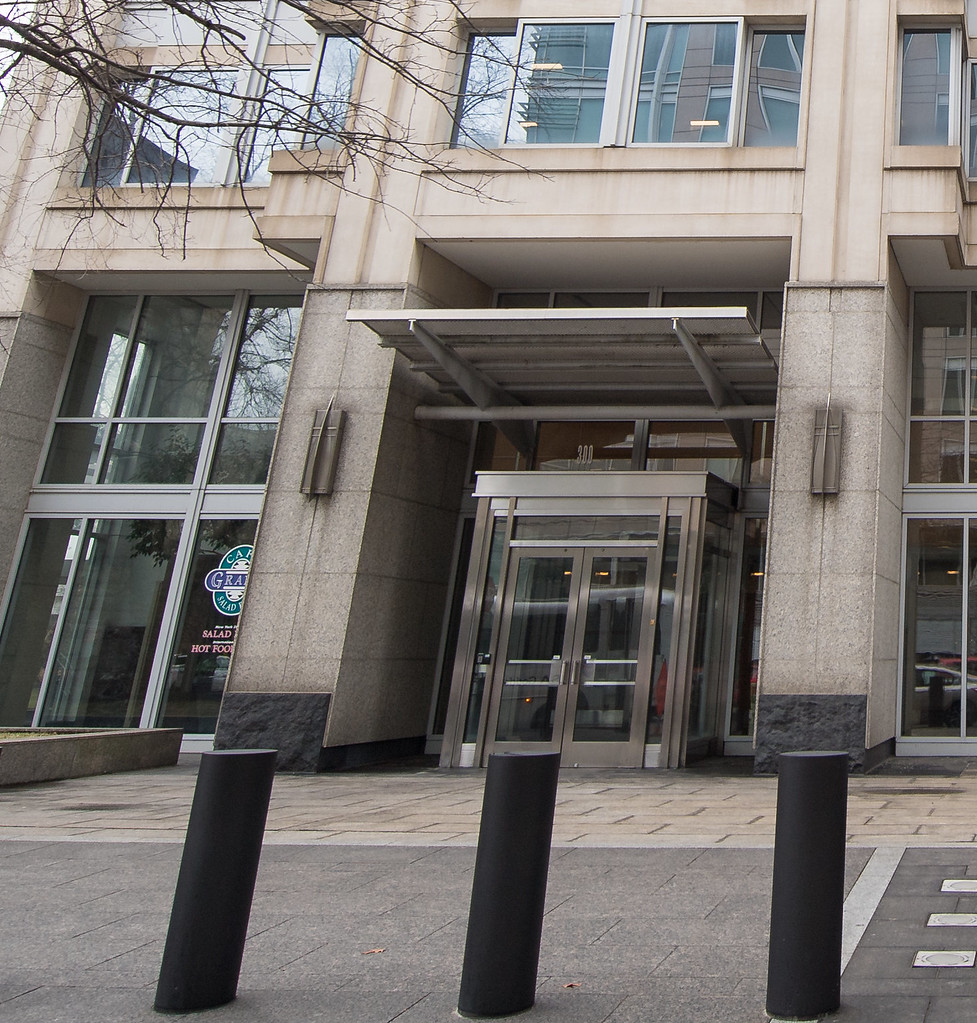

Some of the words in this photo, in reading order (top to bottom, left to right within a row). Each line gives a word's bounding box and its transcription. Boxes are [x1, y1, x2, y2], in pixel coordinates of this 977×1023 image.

[576, 445, 594, 464] 300
[217, 595, 238, 611] SALAD
[202, 630, 232, 638] SALAD
[191, 644, 211, 653] HOT
